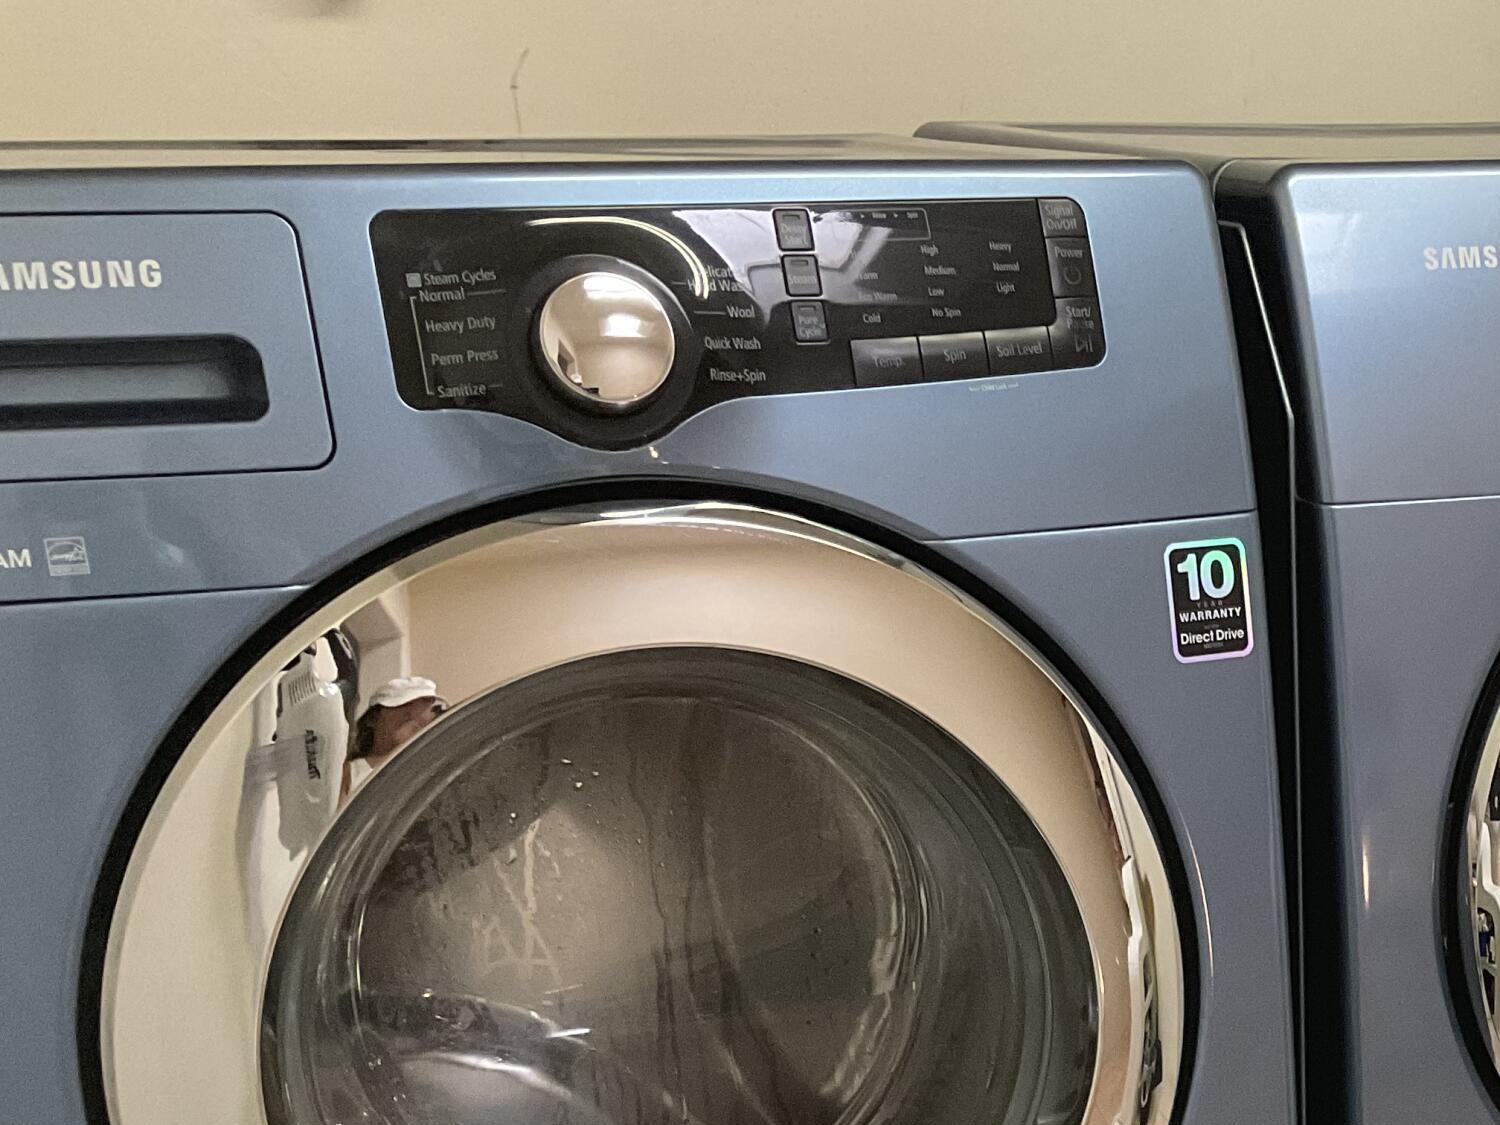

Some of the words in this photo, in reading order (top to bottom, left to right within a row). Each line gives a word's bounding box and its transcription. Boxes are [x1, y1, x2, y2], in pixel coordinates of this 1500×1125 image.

[1054, 246, 1083, 258] Power
[423, 273, 460, 286] Steam
[462, 268, 497, 286] Cycles
[687, 279, 717, 292] Hd
[719, 279, 750, 292] Was
[419, 286, 466, 302] Normal
[726, 304, 756, 318] Wool
[931, 306, 944, 317] No
[425, 319, 464, 334] Heavy
[466, 316, 496, 330] Duty
[704, 336, 732, 350] Quick
[732, 336, 762, 350] Wash
[995, 345, 1015, 358] Soil
[1016, 341, 1043, 356] Level
[430, 352, 464, 366] Perm
[466, 349, 499, 362] Press
[943, 349, 967, 364] Spin
[709, 367, 767, 385] Rinse+Spin
[437, 383, 487, 398] Sanitize
[1177, 550, 1235, 601] 10
[1179, 607, 1242, 623] WARRANTY
[1180, 630, 1214, 646] Direct
[1216, 628, 1245, 641] Drive
